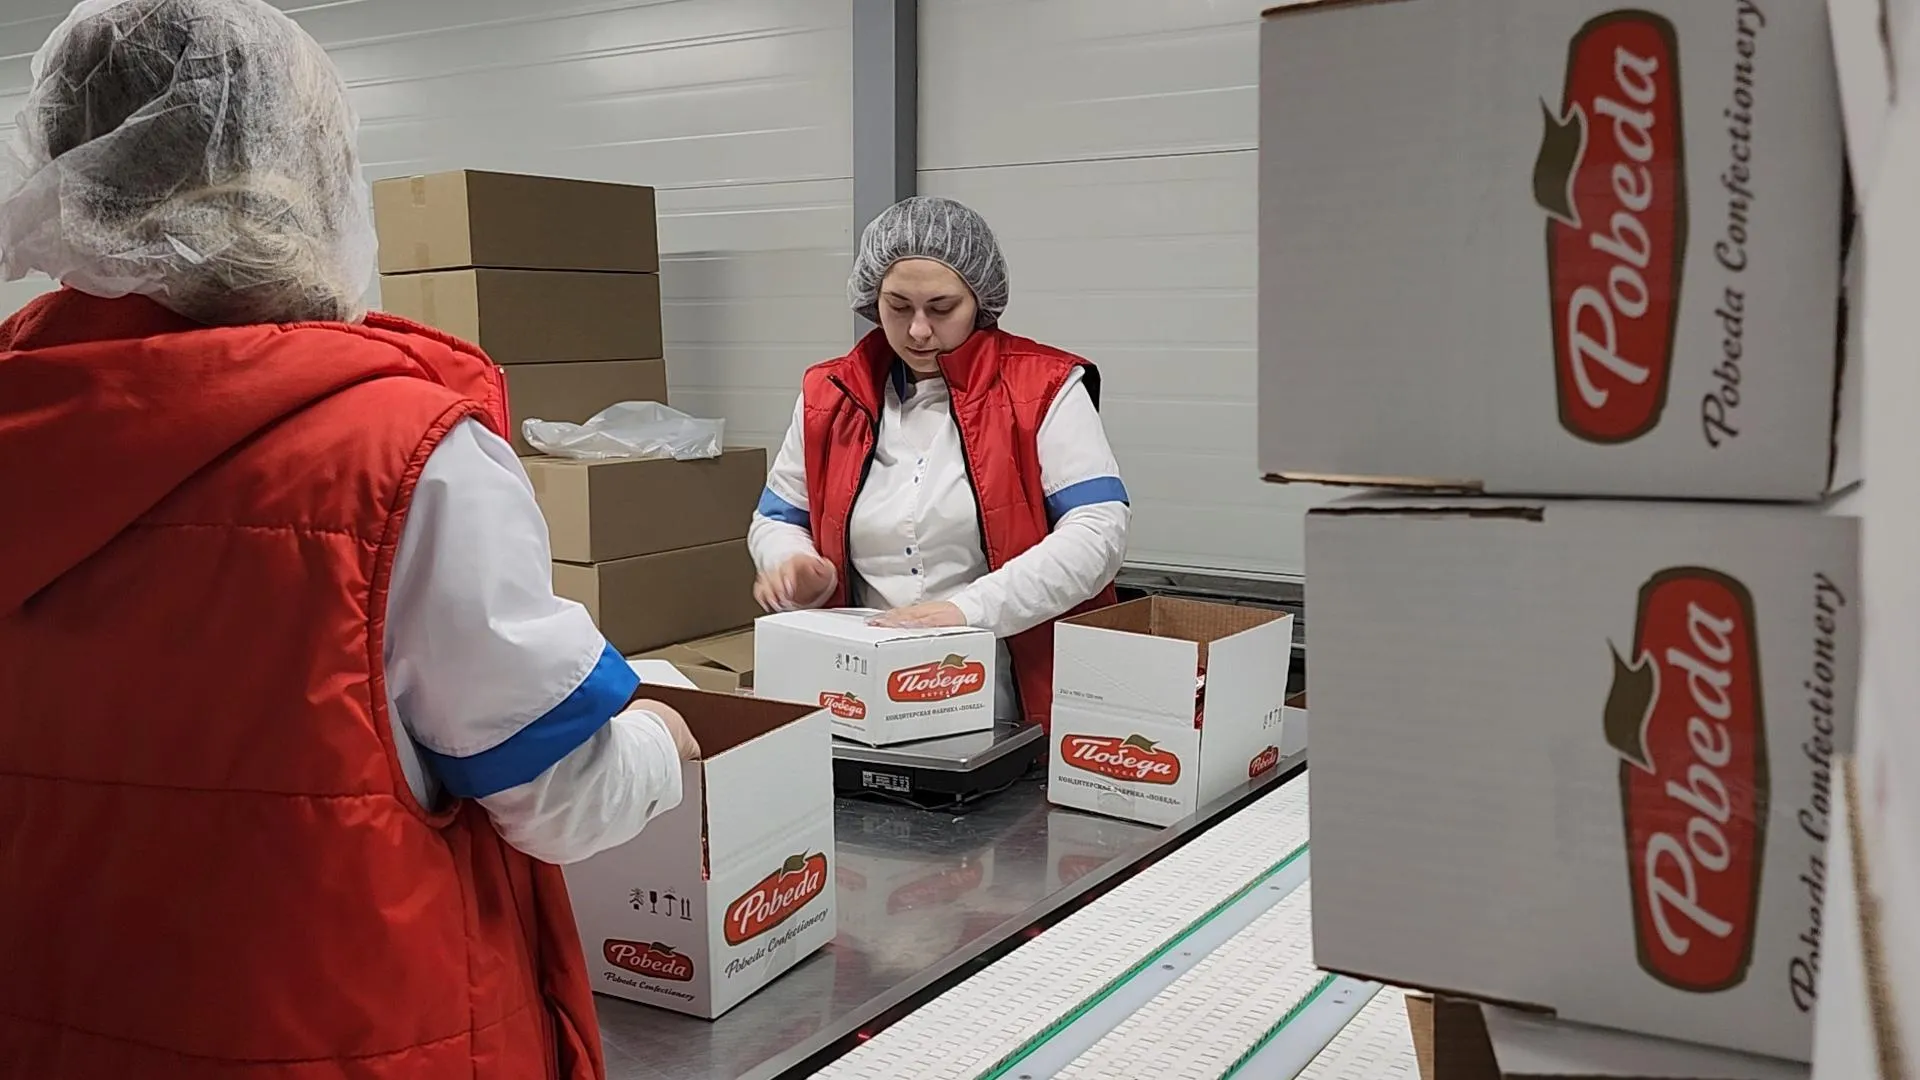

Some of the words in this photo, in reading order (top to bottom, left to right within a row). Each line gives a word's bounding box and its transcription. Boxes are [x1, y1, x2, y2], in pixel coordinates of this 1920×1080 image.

[1713, 0, 1766, 274] Confectionery
[1568, 46, 1658, 408] Pobeda
[1701, 288, 1746, 449] Pobeda
[897, 667, 978, 694] Победа
[1072, 738, 1171, 778] Победа
[1646, 602, 1736, 955] Pobeda
[732, 870, 820, 934] Pobeda
[610, 944, 687, 977] Pobeda
[724, 947, 766, 979] Pobeda
[767, 908, 829, 953] Confectionery
[603, 971, 638, 988] Pobeda
[638, 981, 696, 1002] Confectionery
